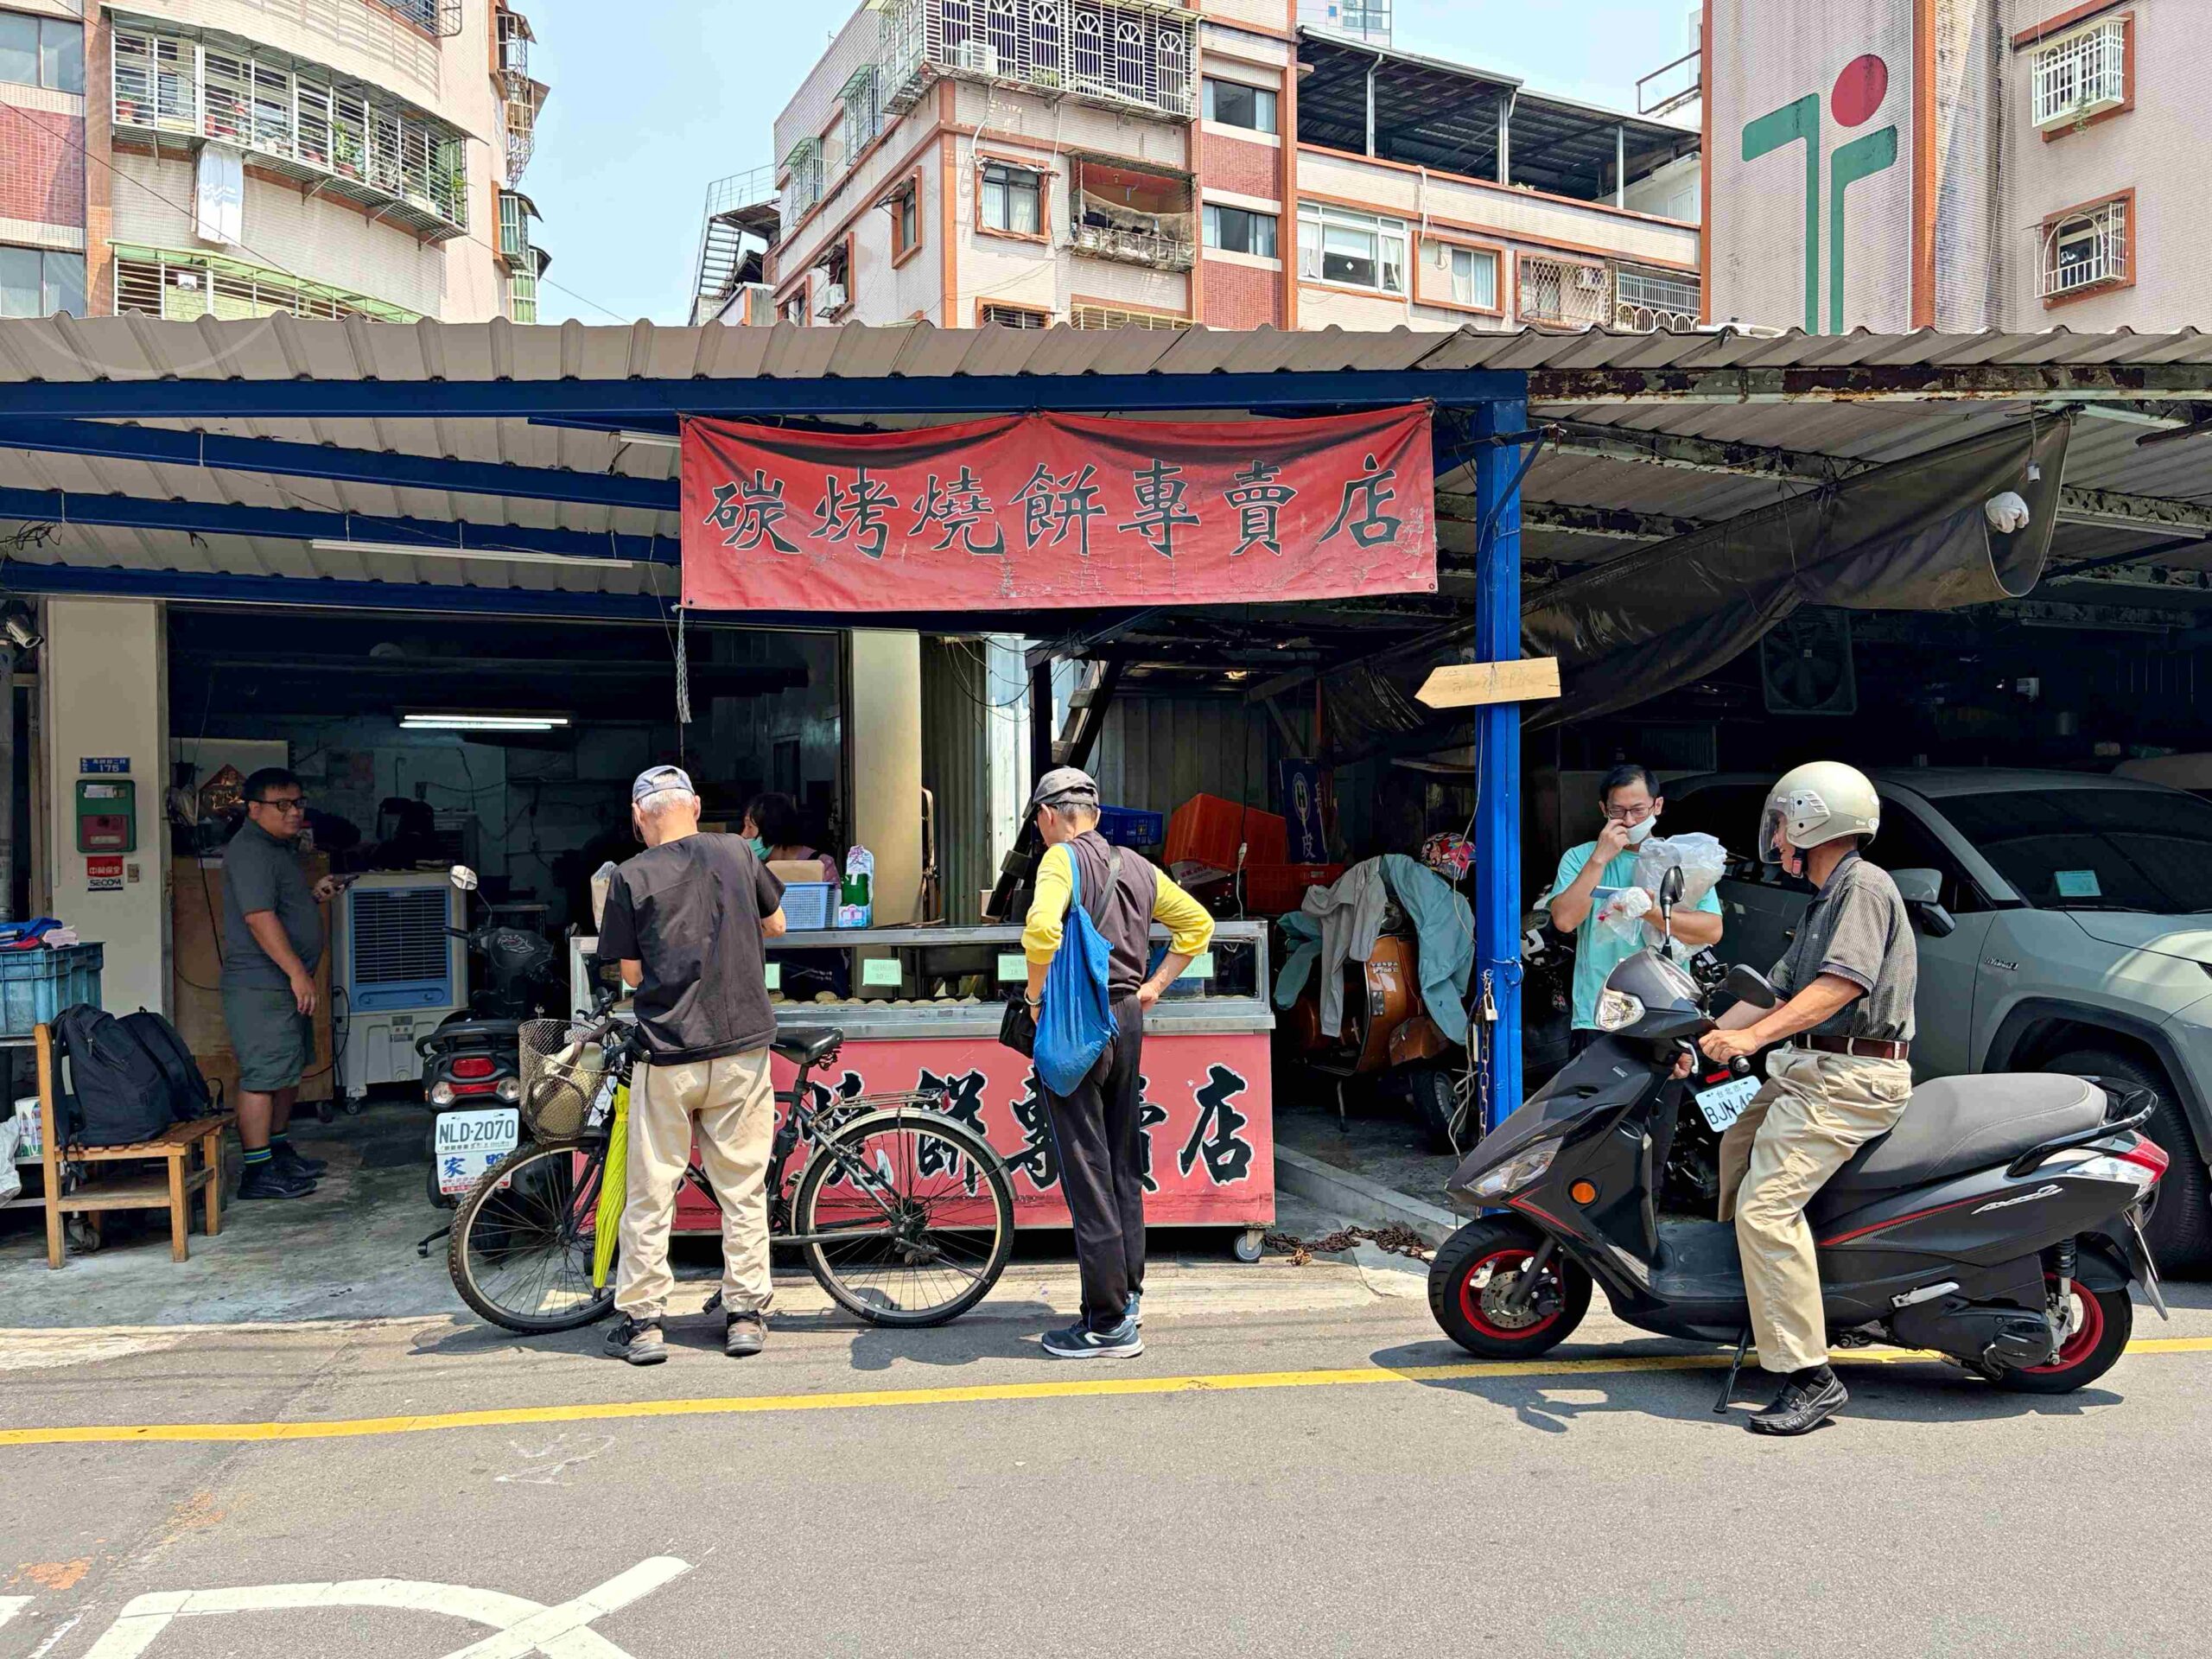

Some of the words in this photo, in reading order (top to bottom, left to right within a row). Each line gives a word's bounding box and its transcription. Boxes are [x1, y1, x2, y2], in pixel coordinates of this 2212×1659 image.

[703, 453, 1403, 560] 碳烤燒餅專賣店
